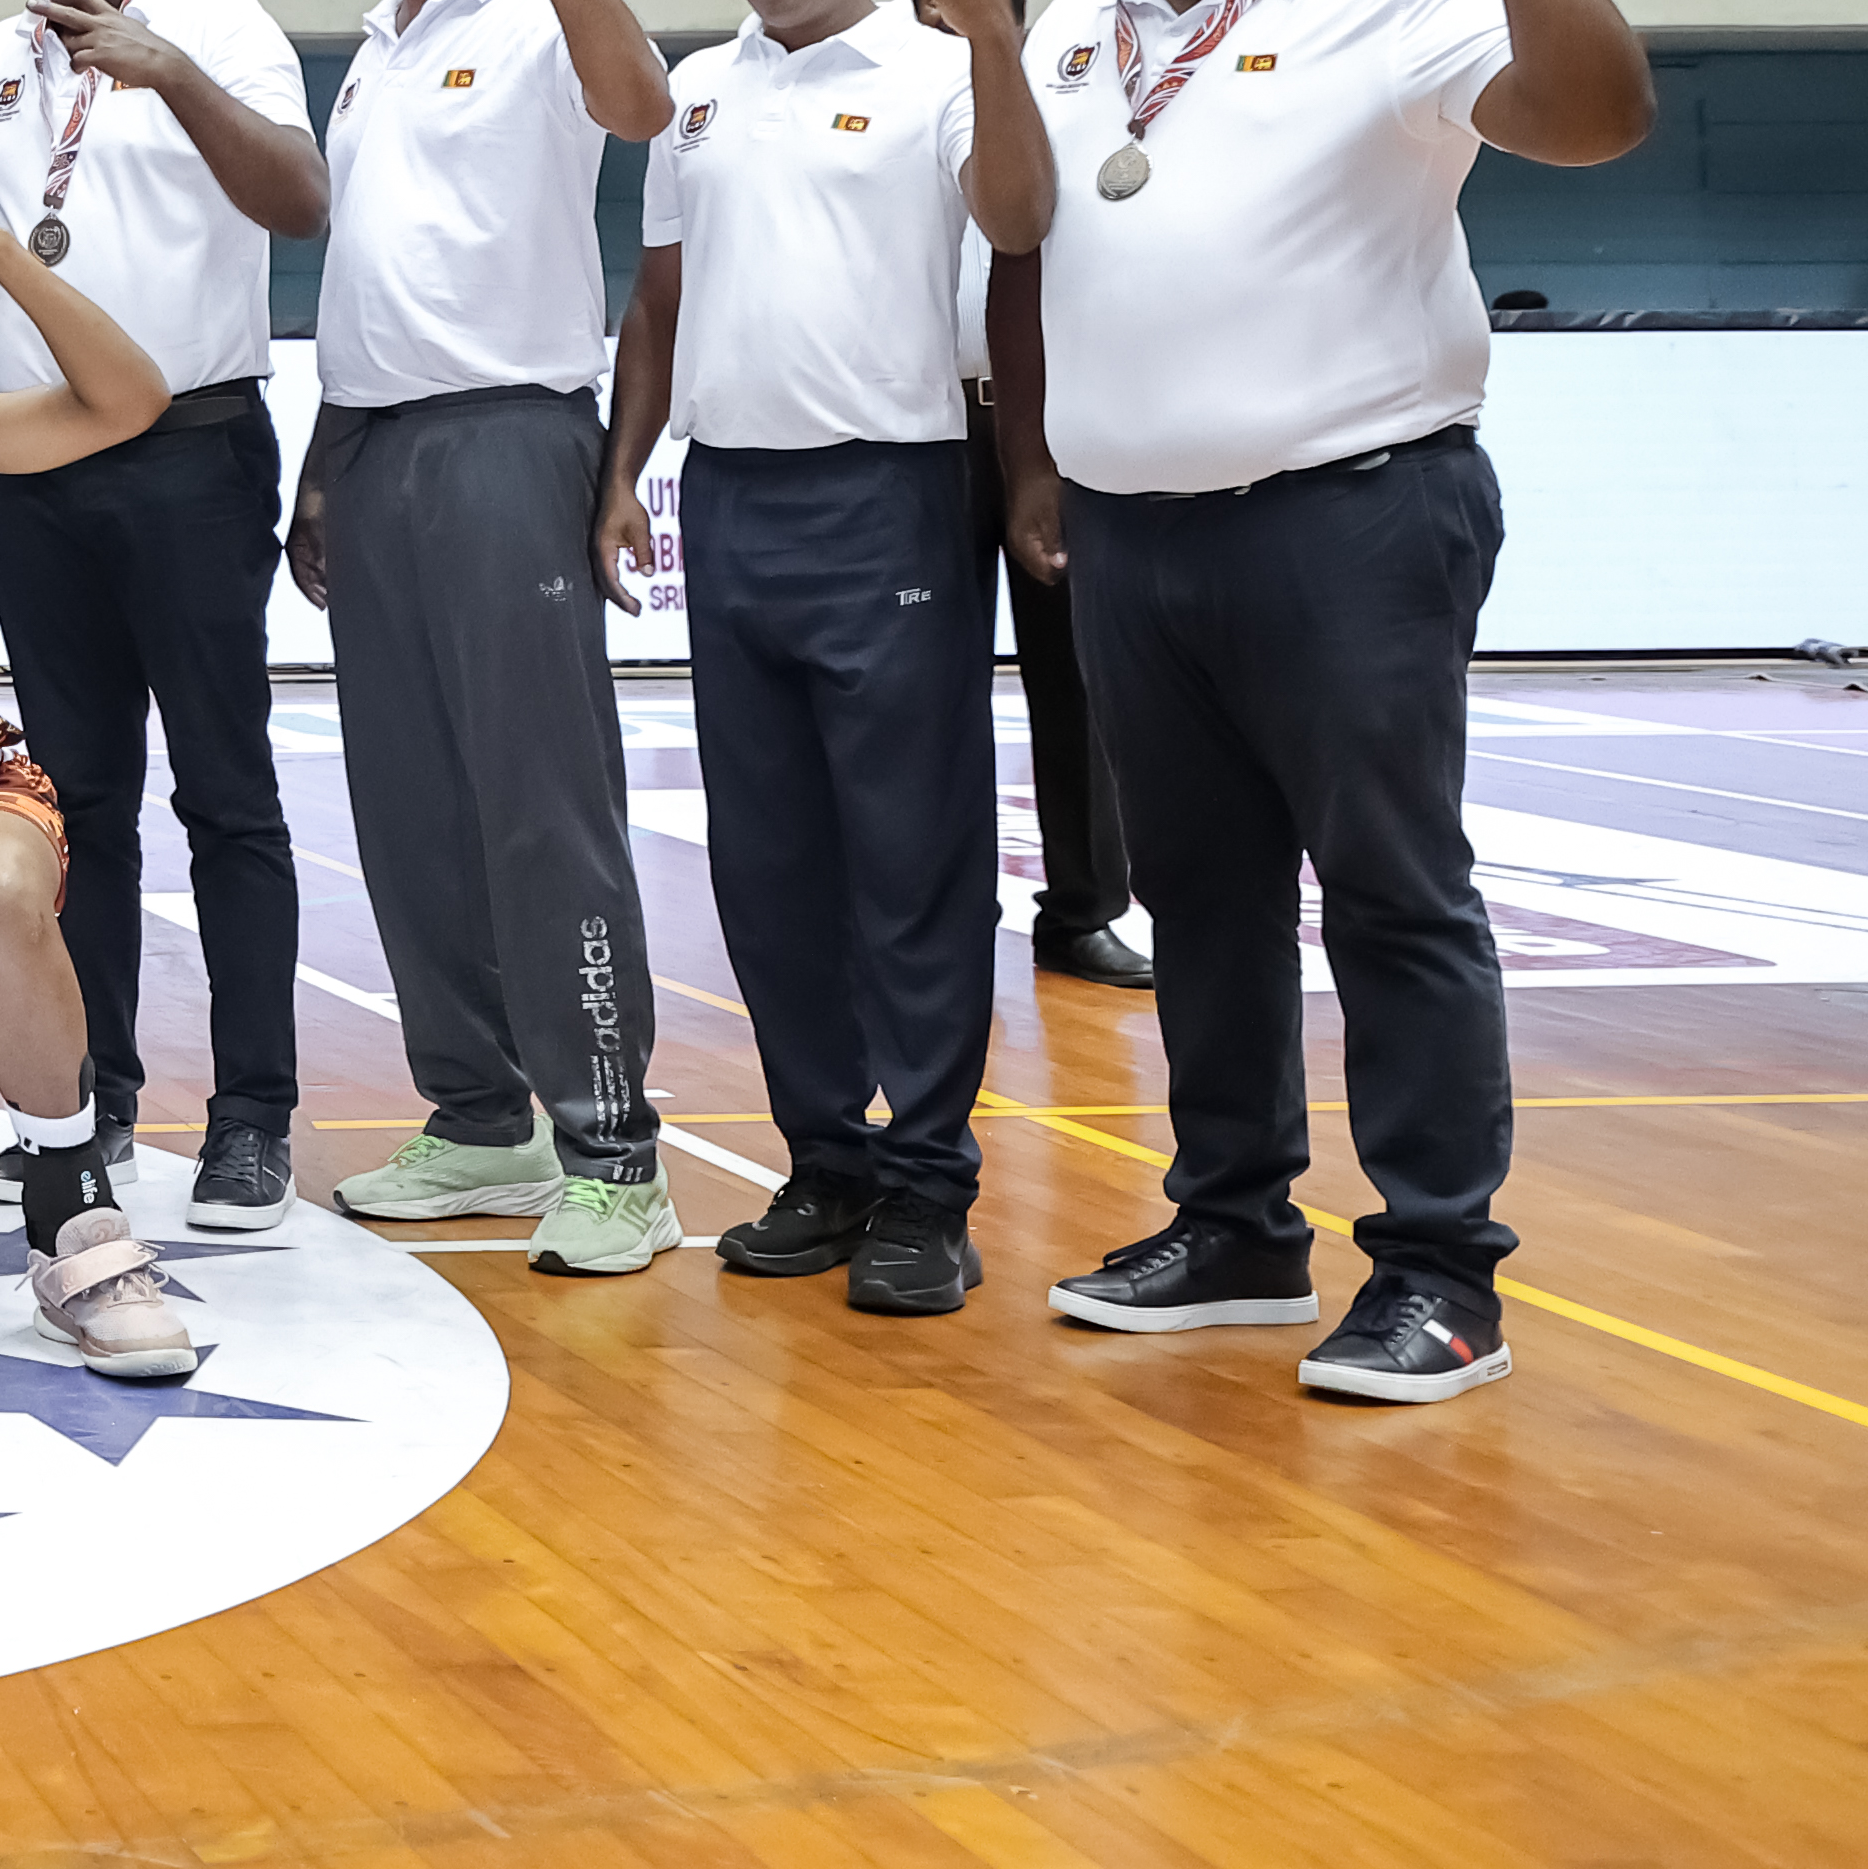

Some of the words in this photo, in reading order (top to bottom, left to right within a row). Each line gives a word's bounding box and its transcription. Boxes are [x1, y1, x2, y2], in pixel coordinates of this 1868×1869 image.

[648, 478, 681, 517] U1
[649, 585, 684, 611] SRI
[578, 915, 621, 1053] adidas
